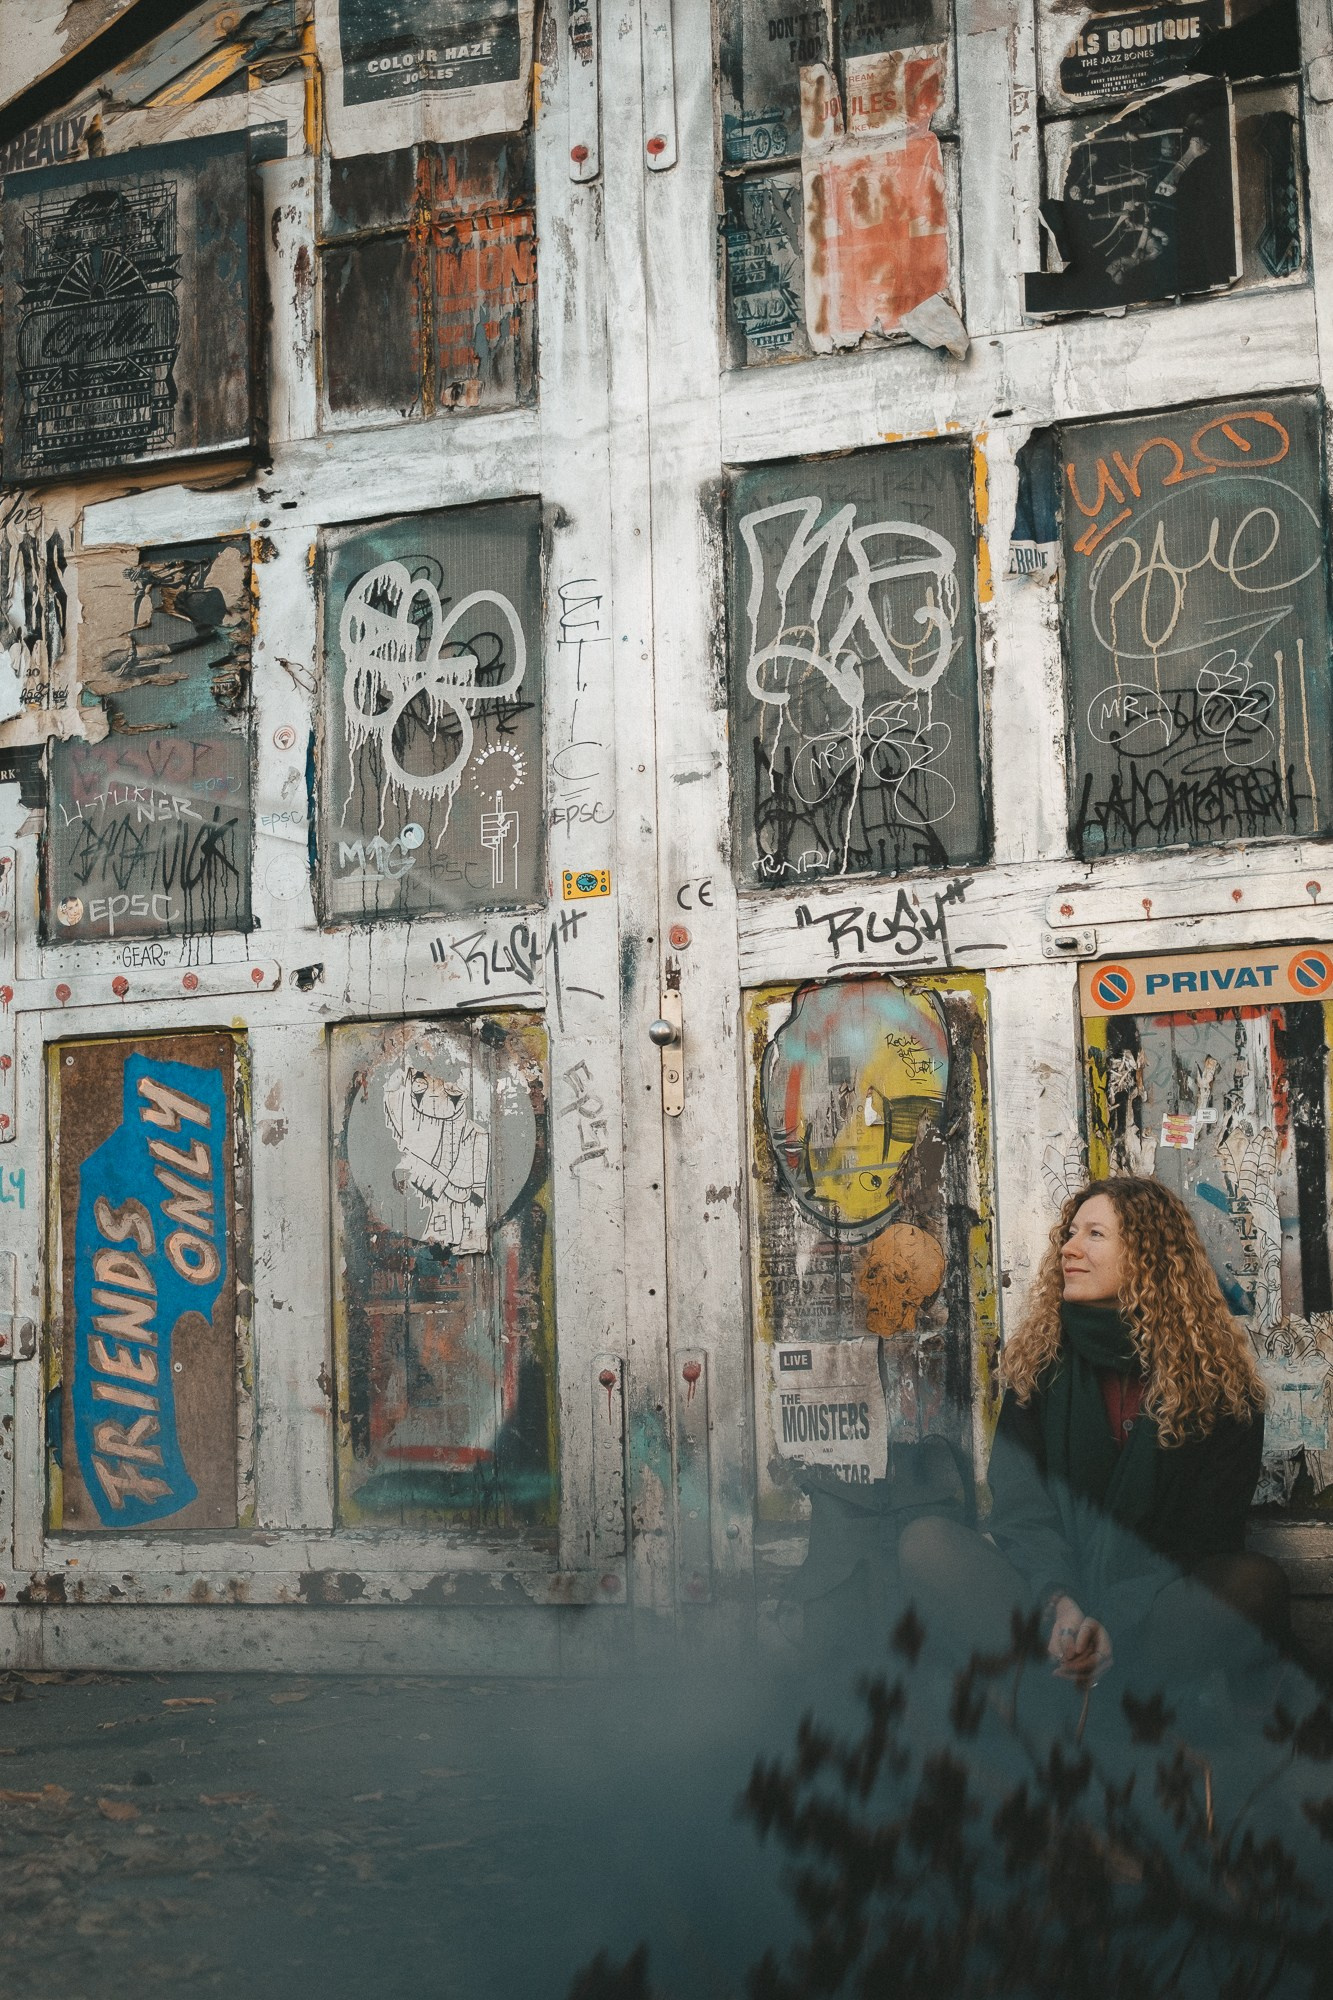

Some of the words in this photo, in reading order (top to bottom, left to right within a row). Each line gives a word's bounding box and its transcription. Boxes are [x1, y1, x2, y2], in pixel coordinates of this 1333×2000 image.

[445, 41, 492, 61] HAZE
[1107, 16, 1201, 52] BOUTIQUE
[1080, 58, 1098, 68] THE
[1100, 54, 1122, 66] JAZZ
[1124, 49, 1155, 61] BONES
[553, 802, 615, 840] EPSC
[88, 893, 180, 936] EPSC
[1145, 965, 1280, 995] PRIVAT
[136, 1075, 221, 1284] ONLY
[88, 1195, 175, 1511] FRIENDS
[783, 1354, 809, 1366] LIVE
[780, 1394, 801, 1405] THE
[782, 1402, 870, 1443] MONSTERS
